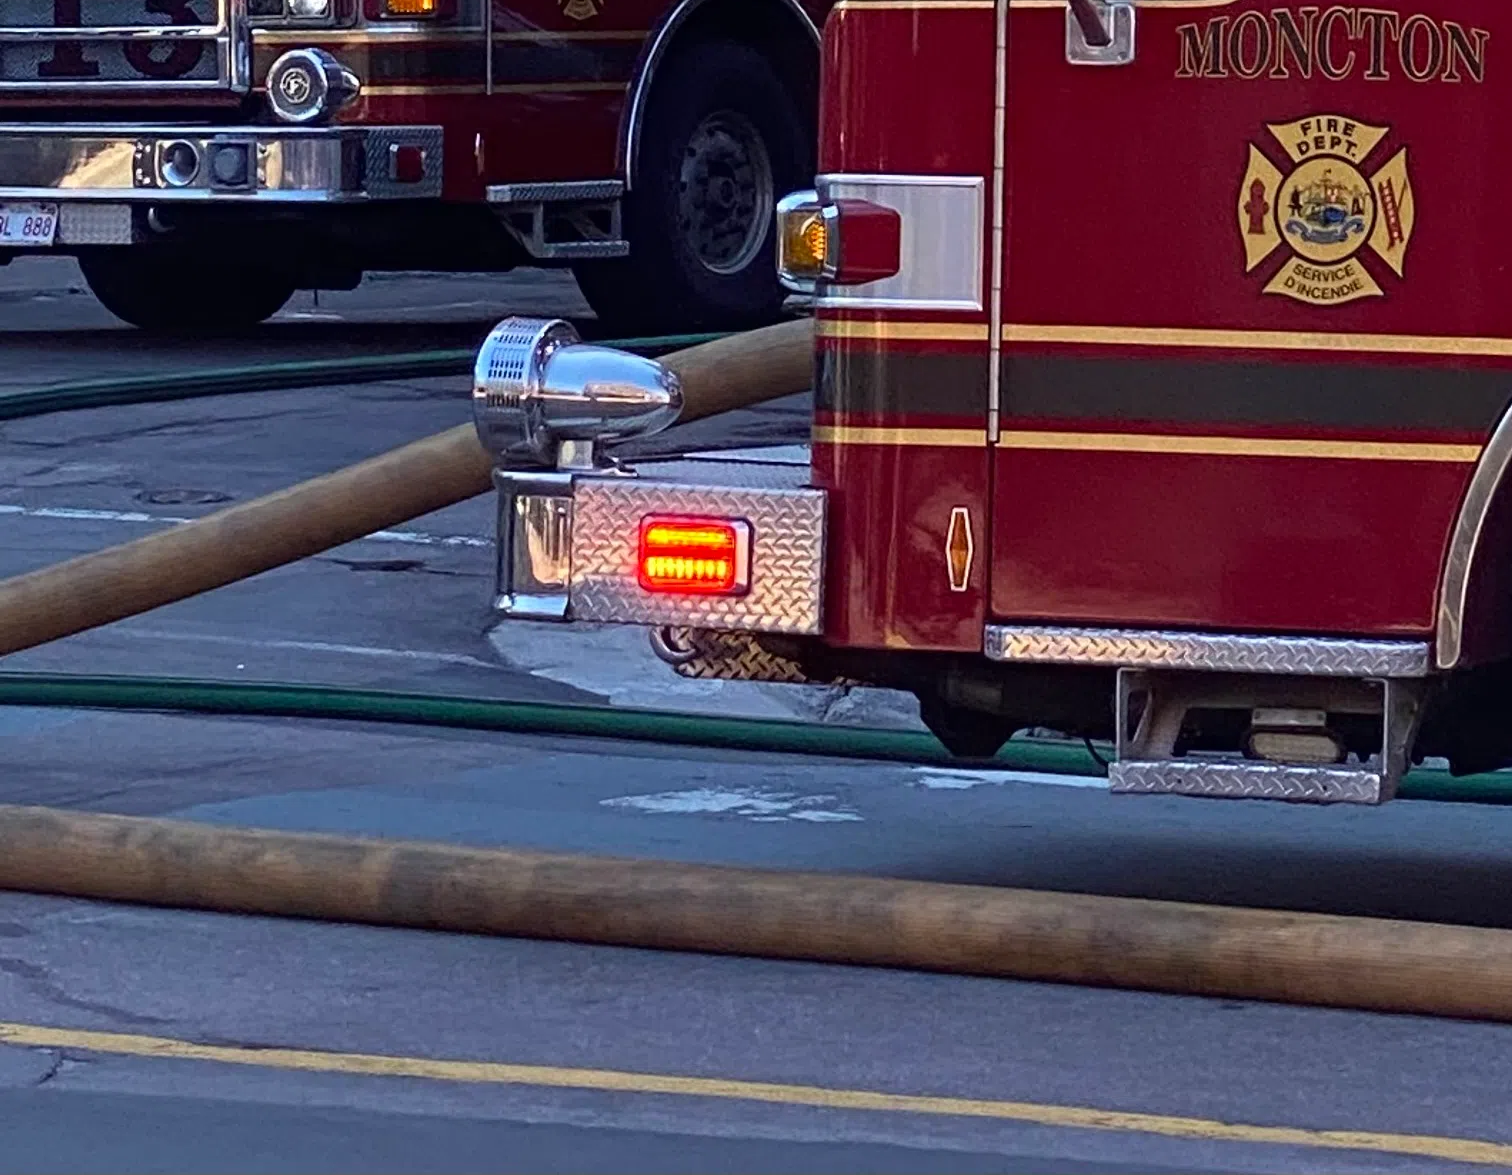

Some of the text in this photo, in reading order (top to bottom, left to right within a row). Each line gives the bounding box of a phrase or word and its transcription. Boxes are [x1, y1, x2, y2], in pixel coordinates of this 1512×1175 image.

[1175, 5, 1490, 83] MONCTON
[1300, 118, 1356, 136] FIRE
[1296, 135, 1358, 157] DEPT.
[22, 216, 52, 237] 888
[1293, 263, 1356, 282] SERVICE
[1284, 276, 1364, 299] D'INCENDIE
